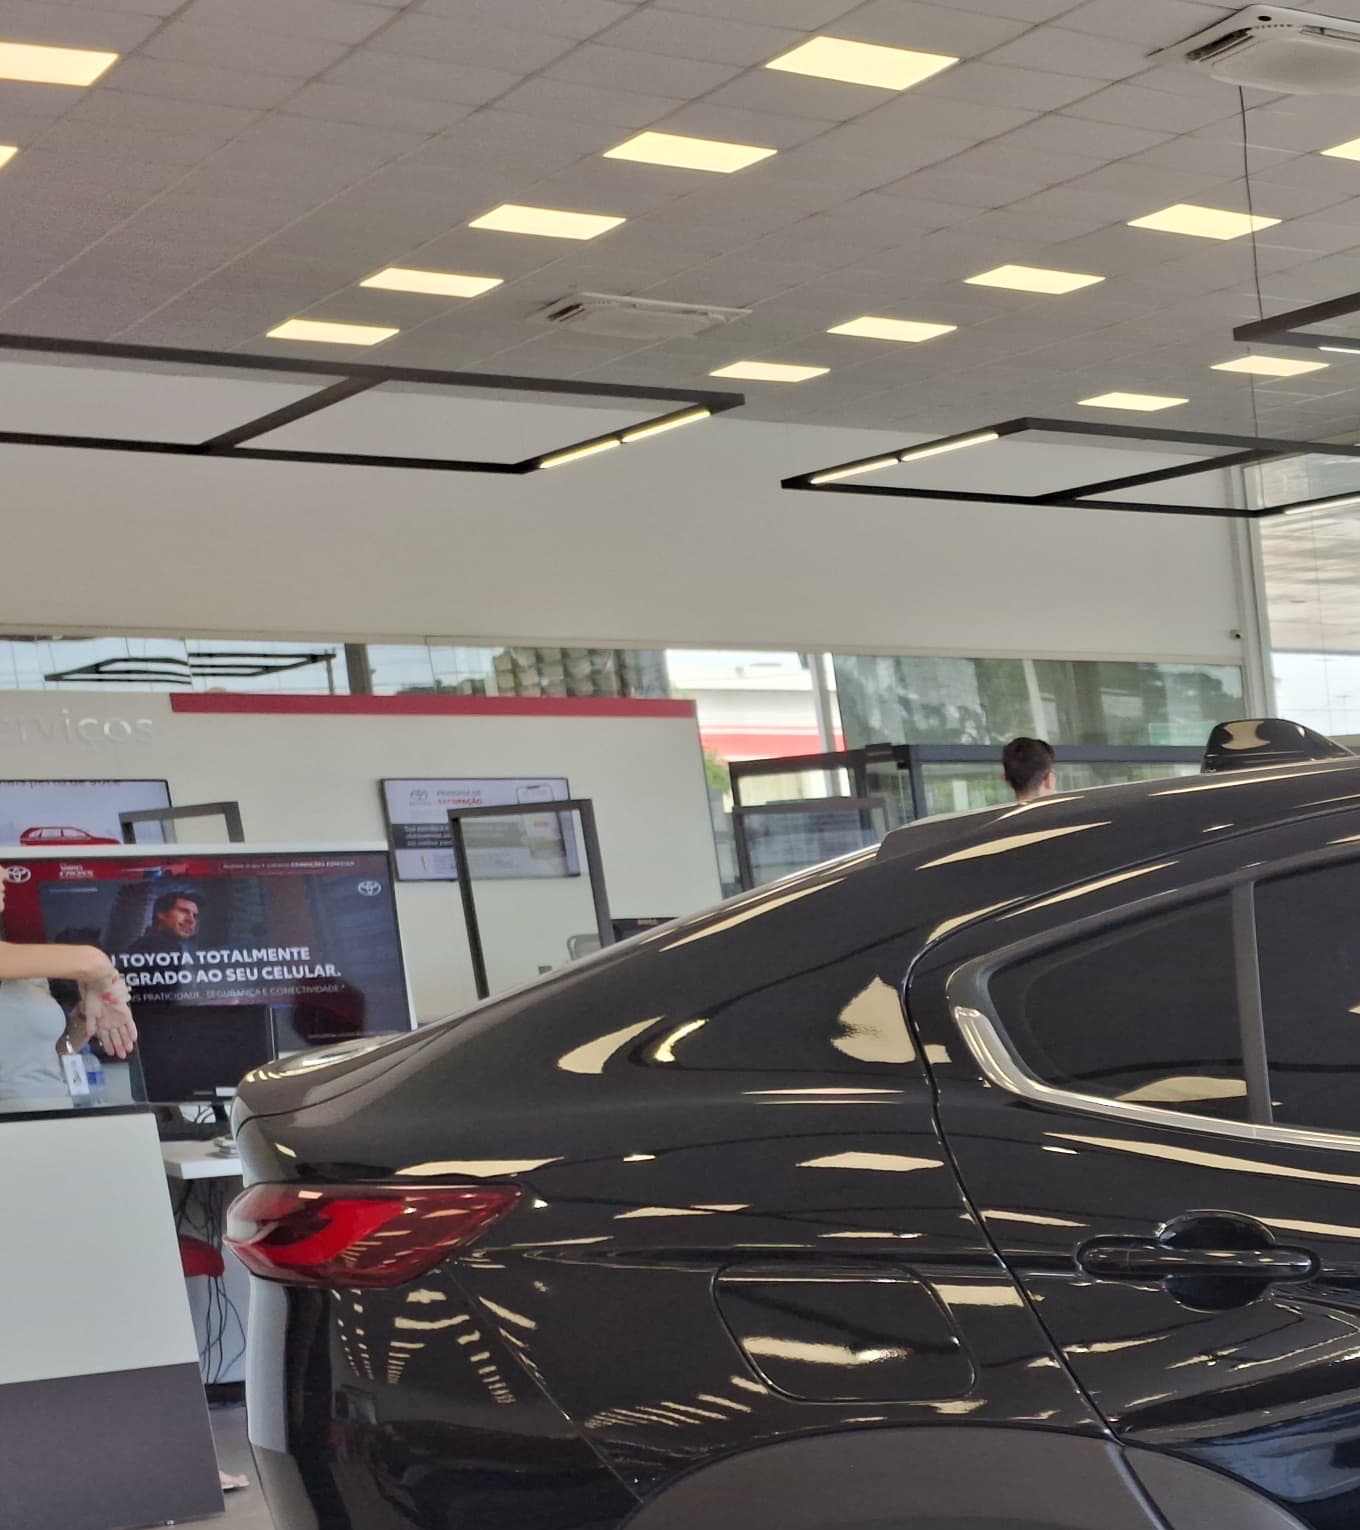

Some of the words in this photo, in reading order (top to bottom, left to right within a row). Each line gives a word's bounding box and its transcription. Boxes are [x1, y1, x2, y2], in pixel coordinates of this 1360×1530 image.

[120, 952, 194, 968] TOYOTA
[196, 947, 310, 964] TOTALMENTE
[119, 969, 192, 987] EGRADO
[196, 968, 223, 984] AO
[226, 966, 258, 982] SEU
[262, 963, 342, 980] CELULAR.
